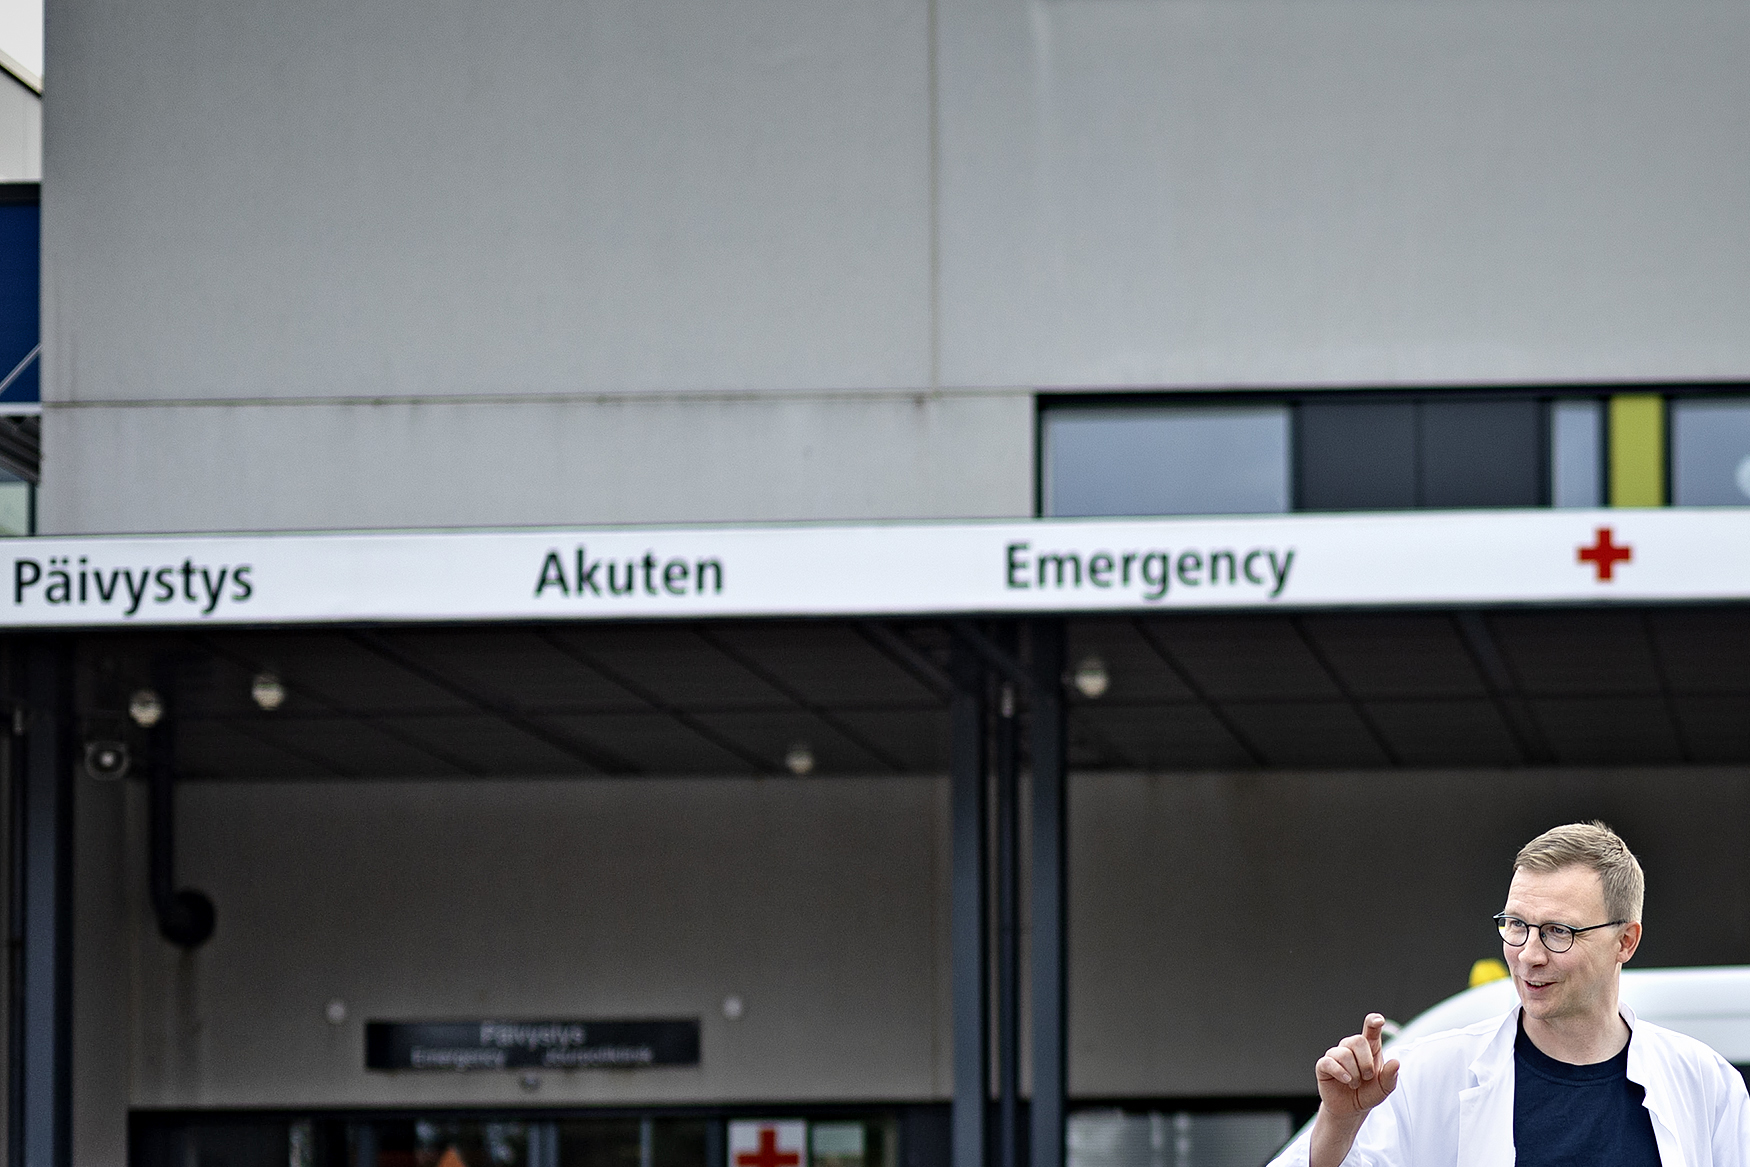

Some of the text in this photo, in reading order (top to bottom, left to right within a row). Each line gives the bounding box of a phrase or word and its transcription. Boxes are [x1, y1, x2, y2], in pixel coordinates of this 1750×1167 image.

[14, 557, 254, 616] Päivystys
[533, 545, 724, 597] Akuten
[1005, 540, 1297, 600] Emergency
